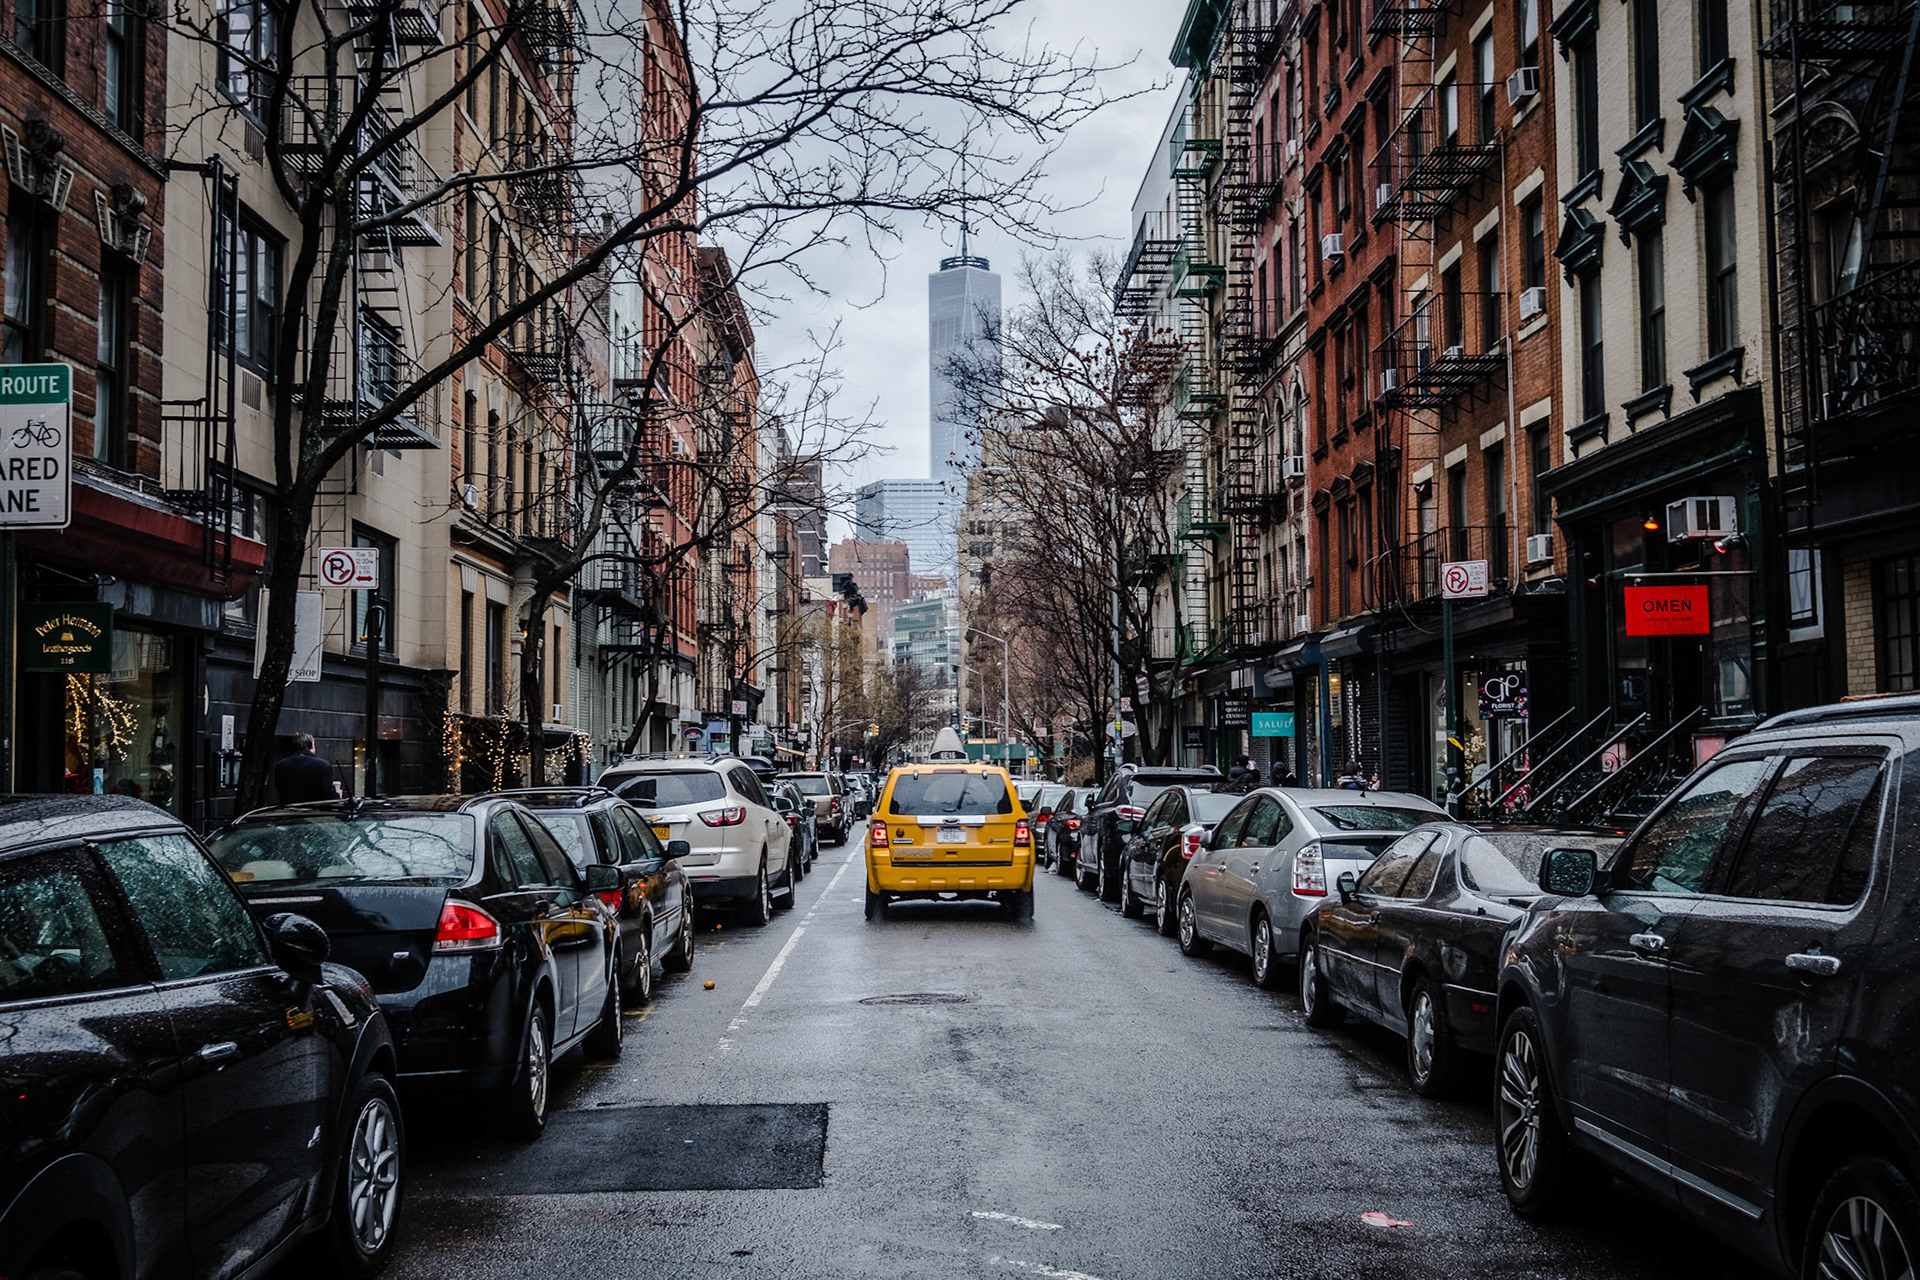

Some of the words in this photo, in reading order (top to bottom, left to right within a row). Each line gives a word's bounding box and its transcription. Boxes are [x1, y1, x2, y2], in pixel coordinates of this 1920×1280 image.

[1, 375, 60, 395] ROUTE
[1642, 599, 1692, 613] OMEN
[34, 617, 60, 637] Peter
[62, 613, 102, 638] Hermann
[294, 668, 317, 677] SHOP
